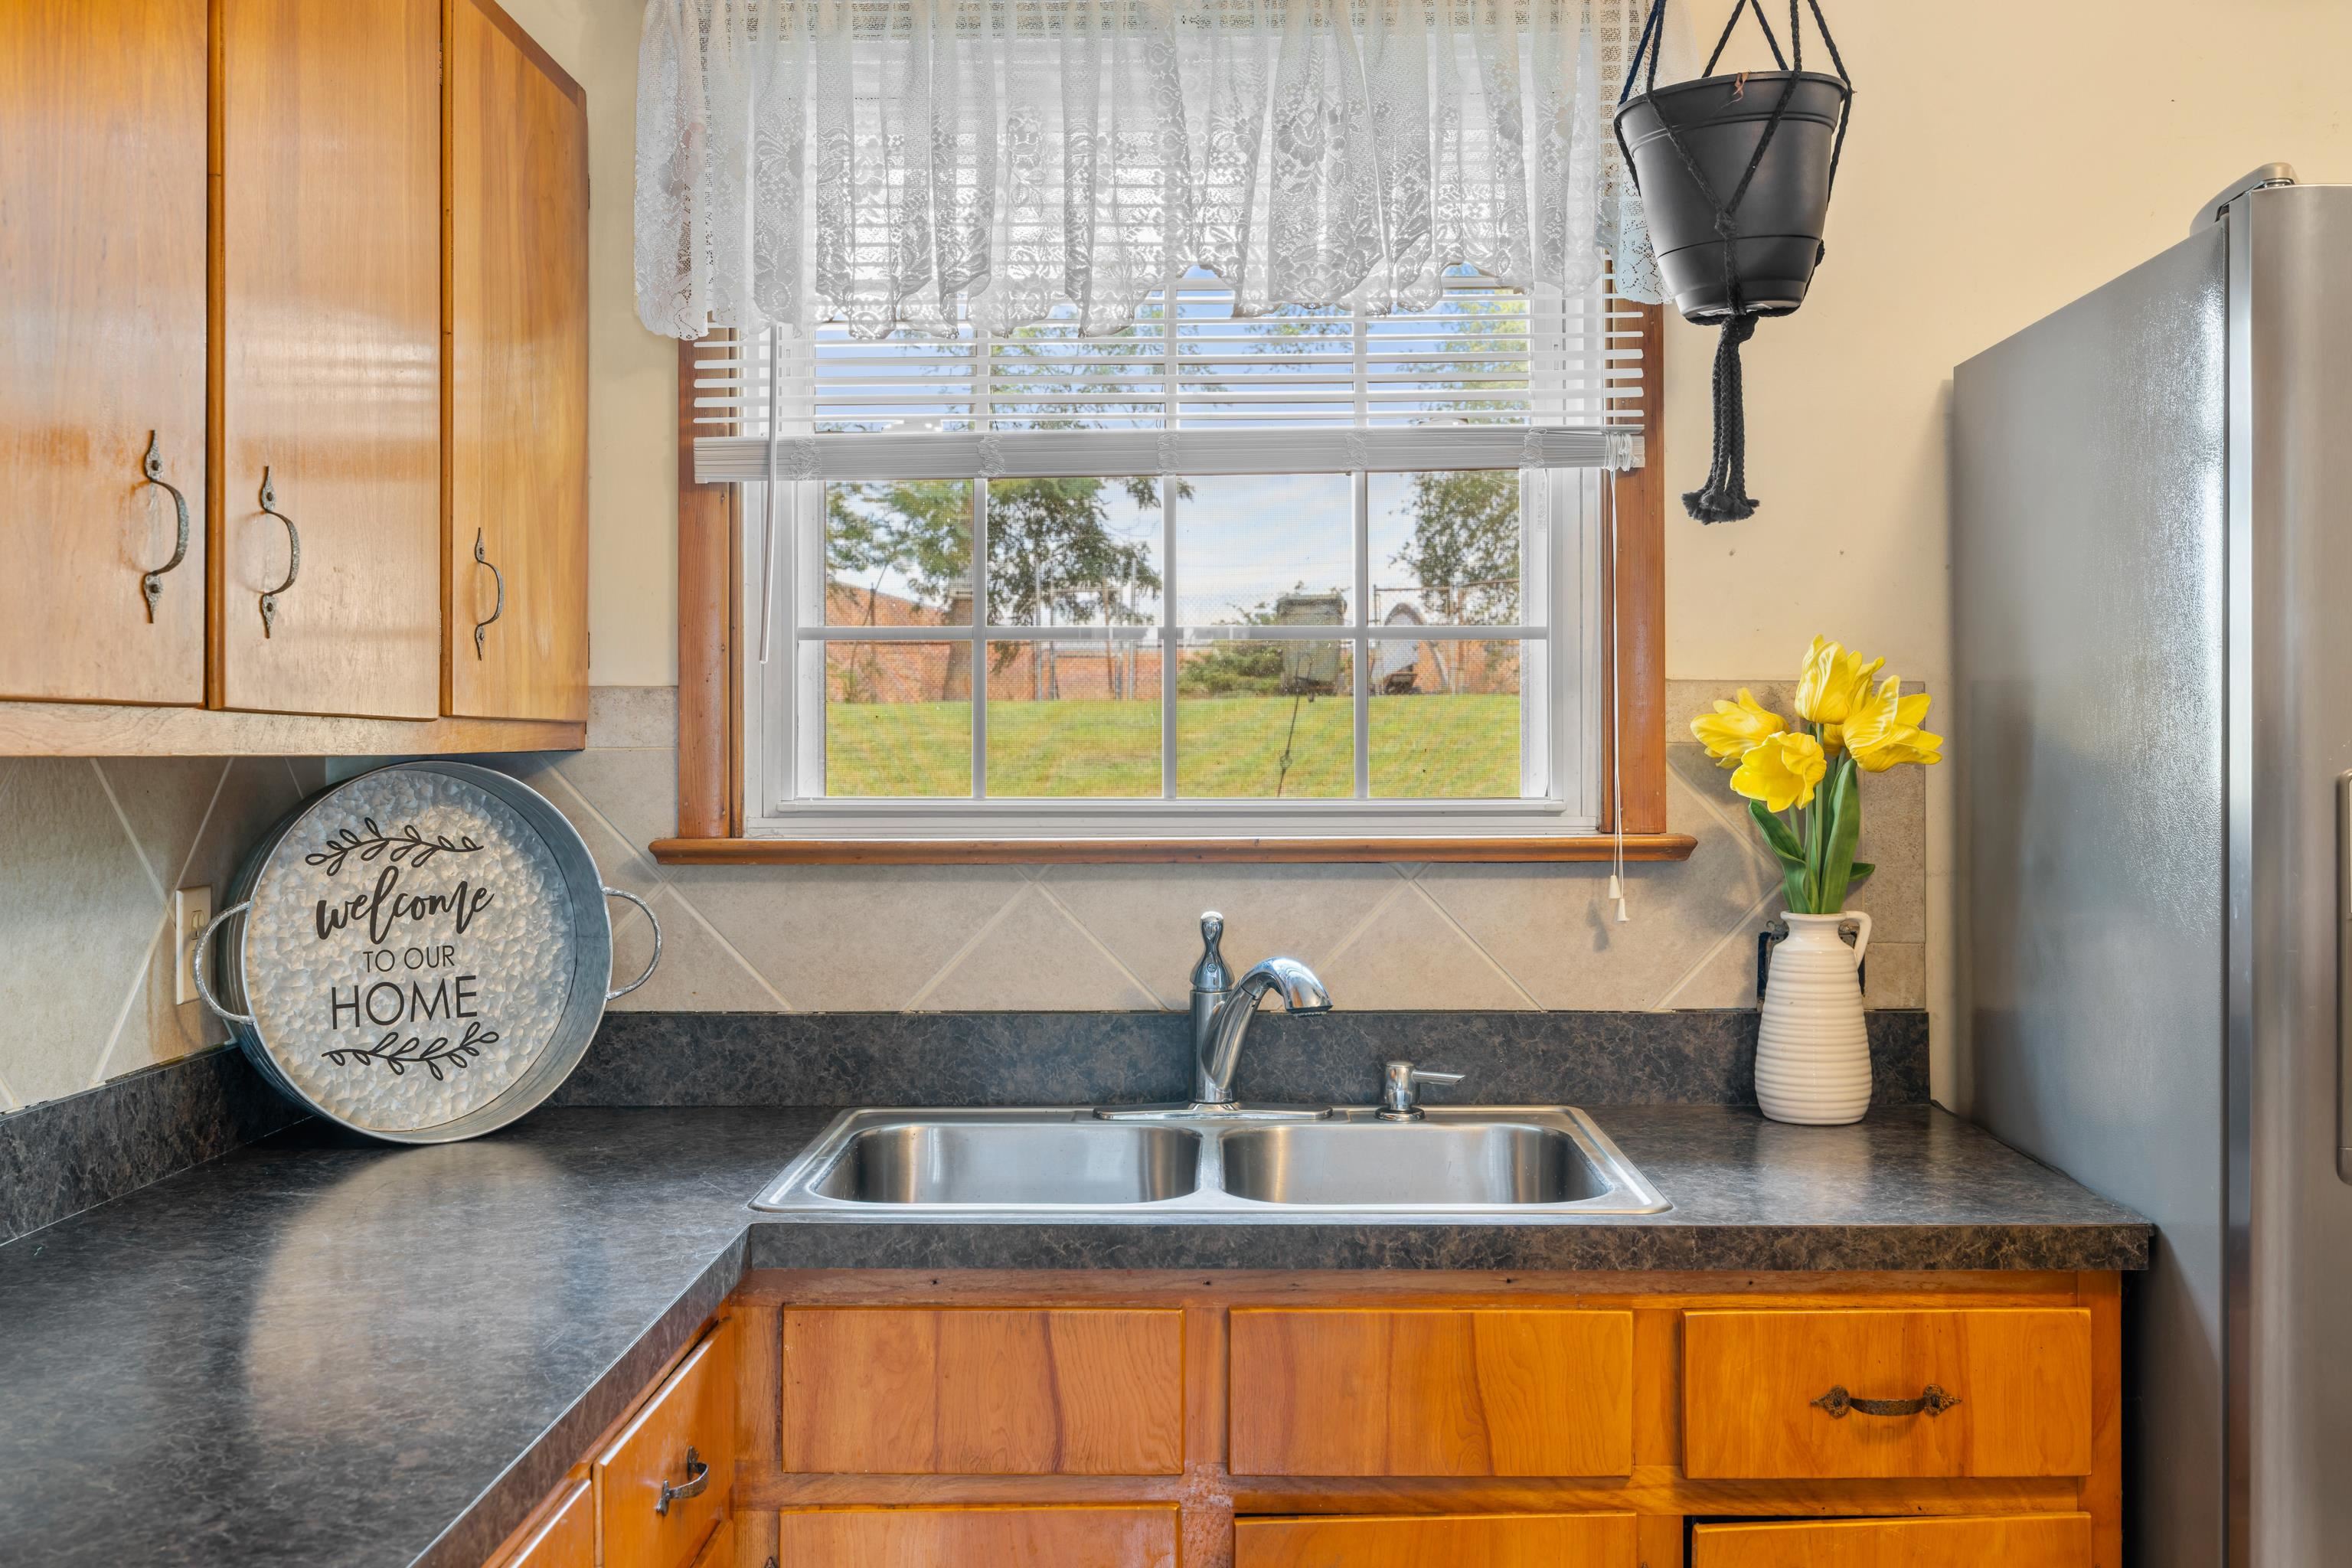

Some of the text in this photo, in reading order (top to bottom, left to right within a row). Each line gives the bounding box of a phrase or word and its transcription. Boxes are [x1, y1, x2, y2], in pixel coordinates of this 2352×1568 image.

[315, 865, 495, 945] welcome
[362, 945, 456, 973] TO OUR
[331, 975, 479, 1030] HOME
